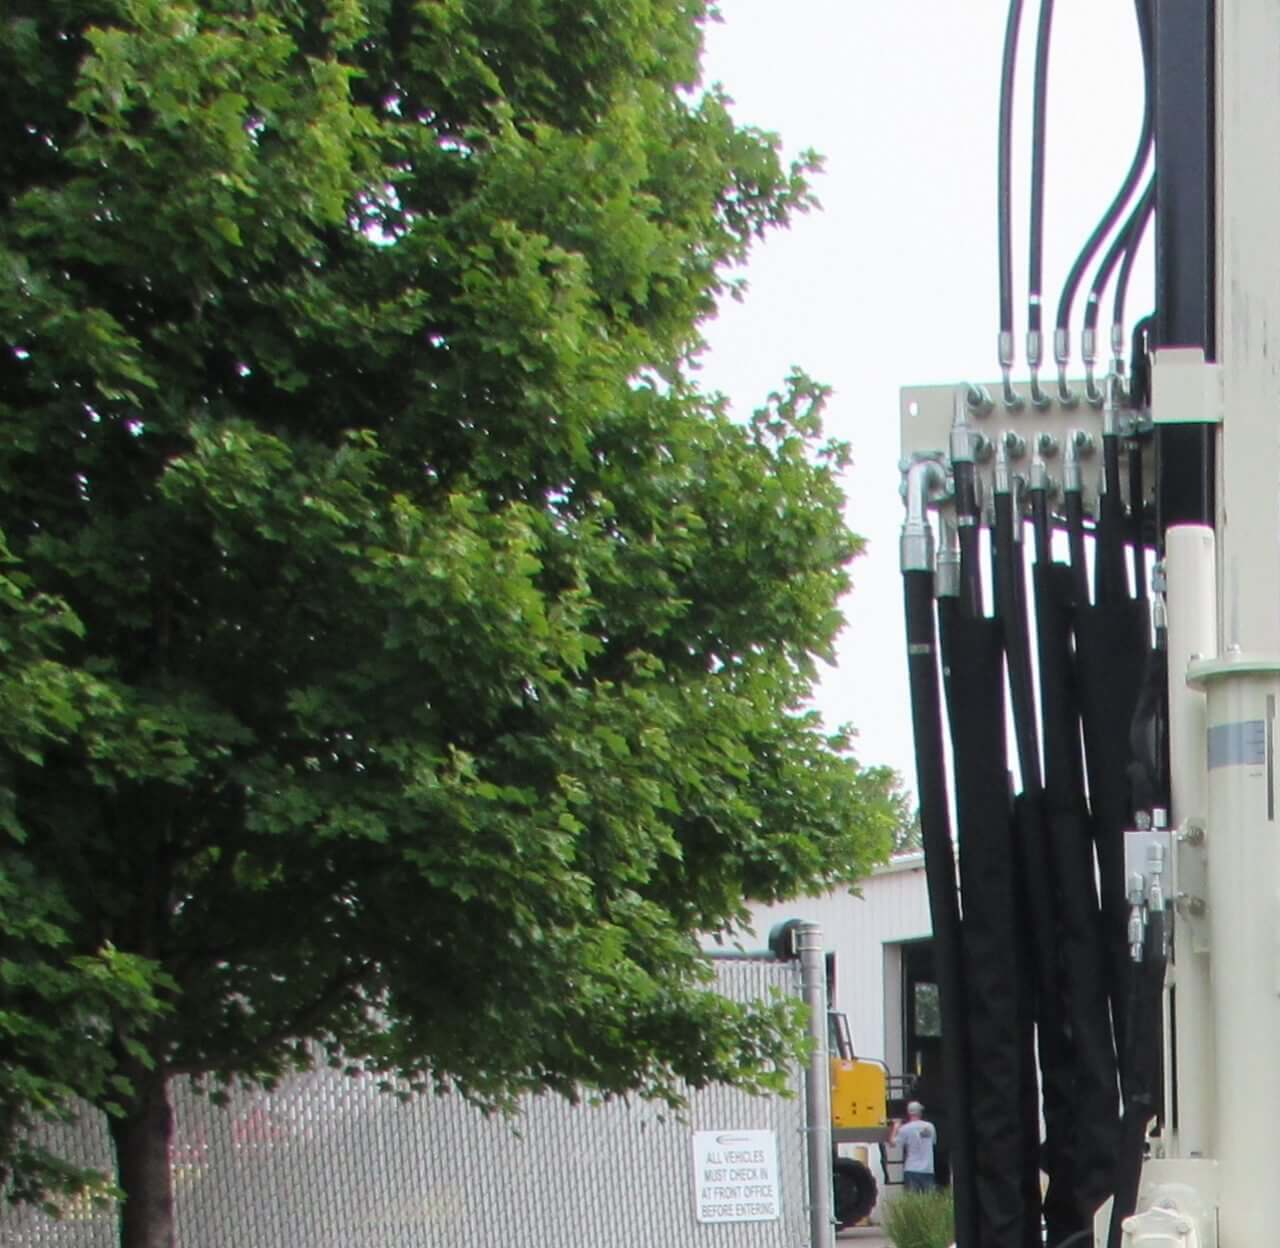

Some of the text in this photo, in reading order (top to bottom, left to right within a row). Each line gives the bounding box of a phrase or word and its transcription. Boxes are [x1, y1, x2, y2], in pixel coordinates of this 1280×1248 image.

[705, 1150, 765, 1164] ALL VEHICLES
[704, 1167, 769, 1182] MUST CHECK IN
[702, 1184, 774, 1200] AT FRONT OFFICE
[702, 1202, 775, 1218] BEFORE ENTERING
